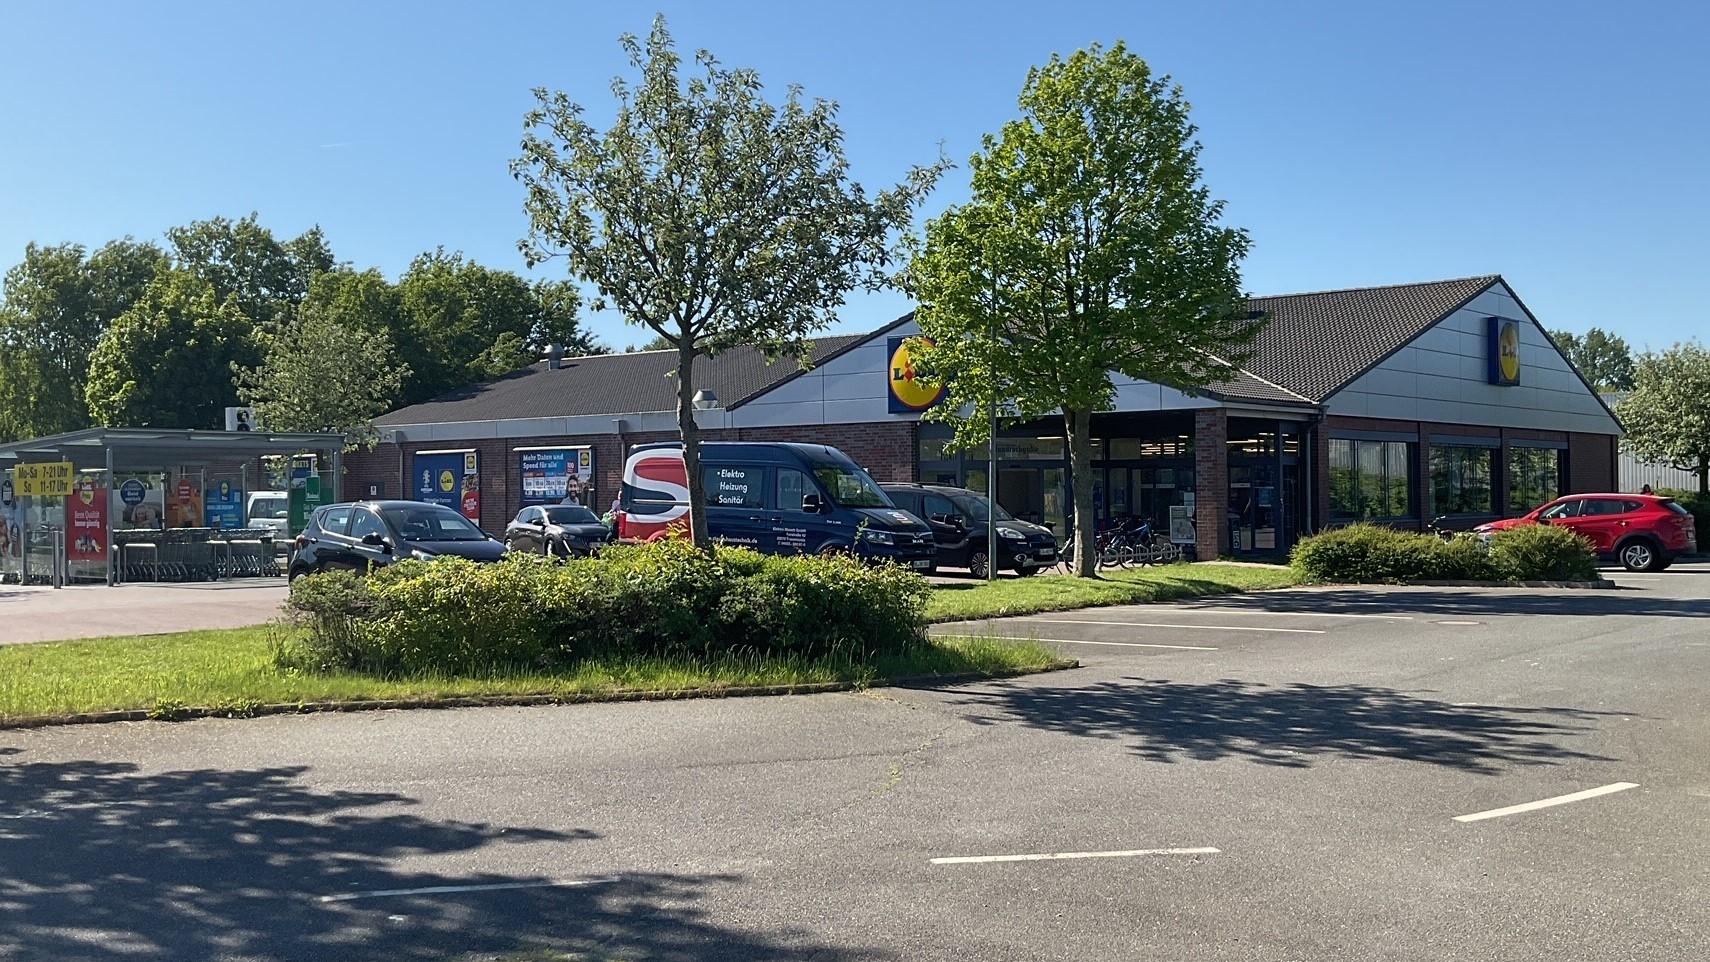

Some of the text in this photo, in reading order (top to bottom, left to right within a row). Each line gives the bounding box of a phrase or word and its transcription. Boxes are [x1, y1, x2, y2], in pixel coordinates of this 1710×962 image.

[523, 462, 539, 470] Speed
[19, 466, 38, 478] Mo-Sa
[57, 465, 68, 477] Uhr
[721, 469, 745, 478] Elektro
[24, 480, 31, 493] So
[40, 480, 56, 492] 11-17
[57, 480, 68, 492] Uhr
[720, 482, 748, 493] Heizung
[718, 495, 744, 504] Sanitär
